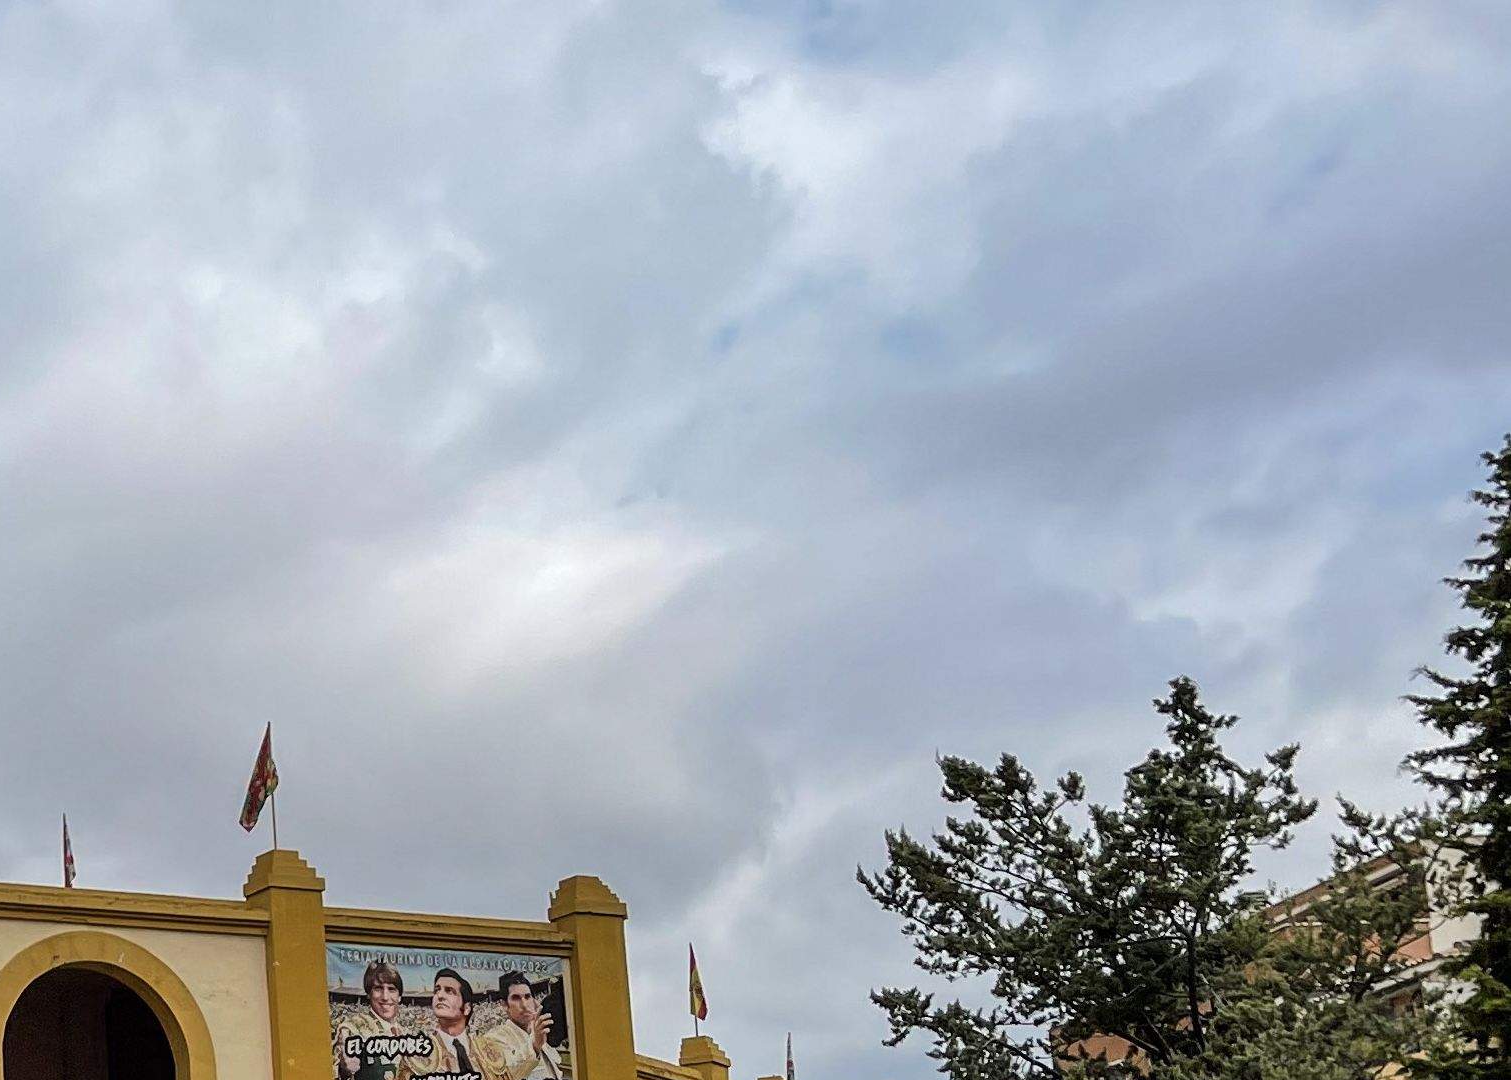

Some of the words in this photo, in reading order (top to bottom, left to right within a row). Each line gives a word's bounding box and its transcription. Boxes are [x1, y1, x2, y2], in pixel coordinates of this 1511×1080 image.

[340, 948, 372, 963] FERIA
[377, 951, 422, 965] TAURINA
[427, 954, 440, 967] DE
[521, 960, 548, 973] 2022
